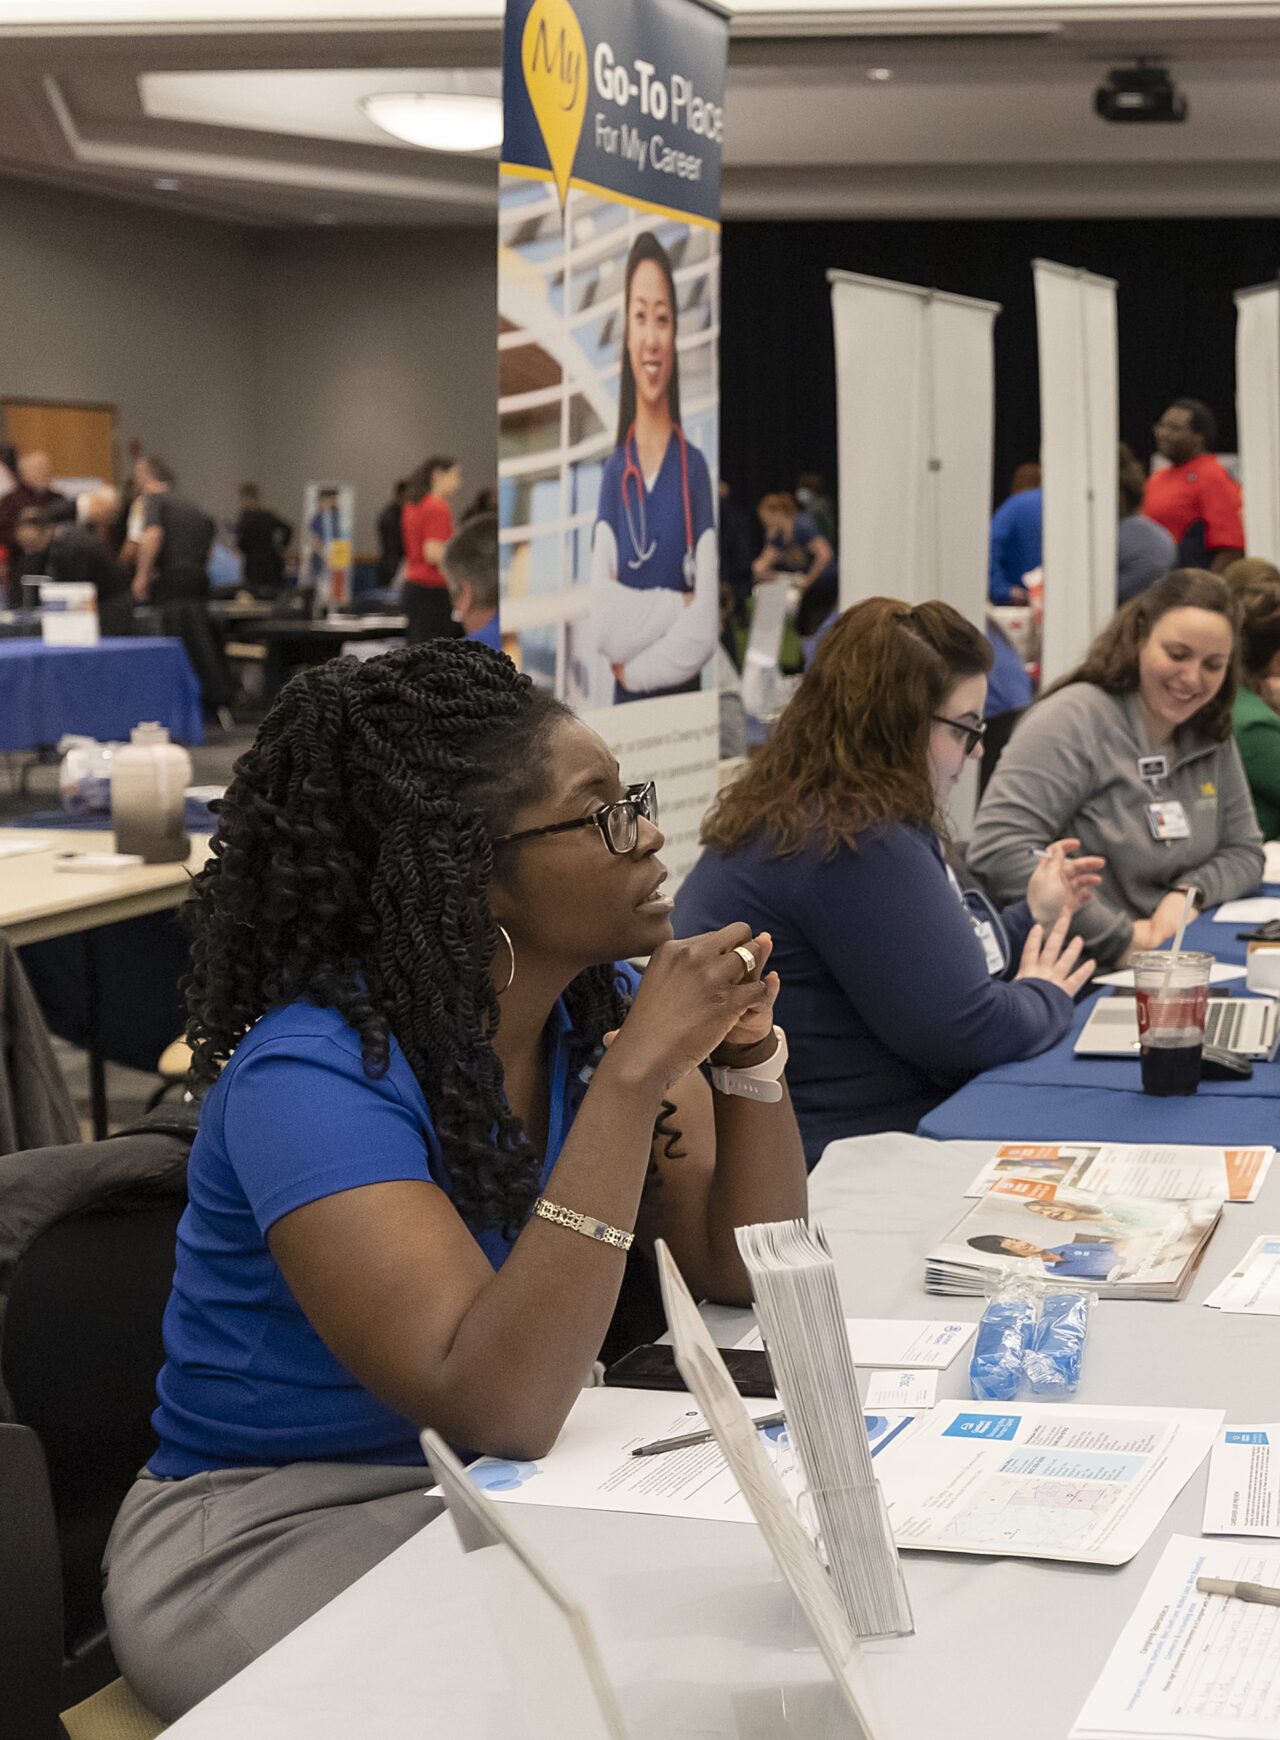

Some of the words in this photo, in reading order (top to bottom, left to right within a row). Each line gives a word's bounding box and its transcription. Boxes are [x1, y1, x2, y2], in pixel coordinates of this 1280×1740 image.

[533, 19, 580, 111] My
[594, 42, 668, 120] Go-To
[595, 112, 618, 154] For
[621, 124, 649, 171] My
[650, 134, 703, 181] Career
